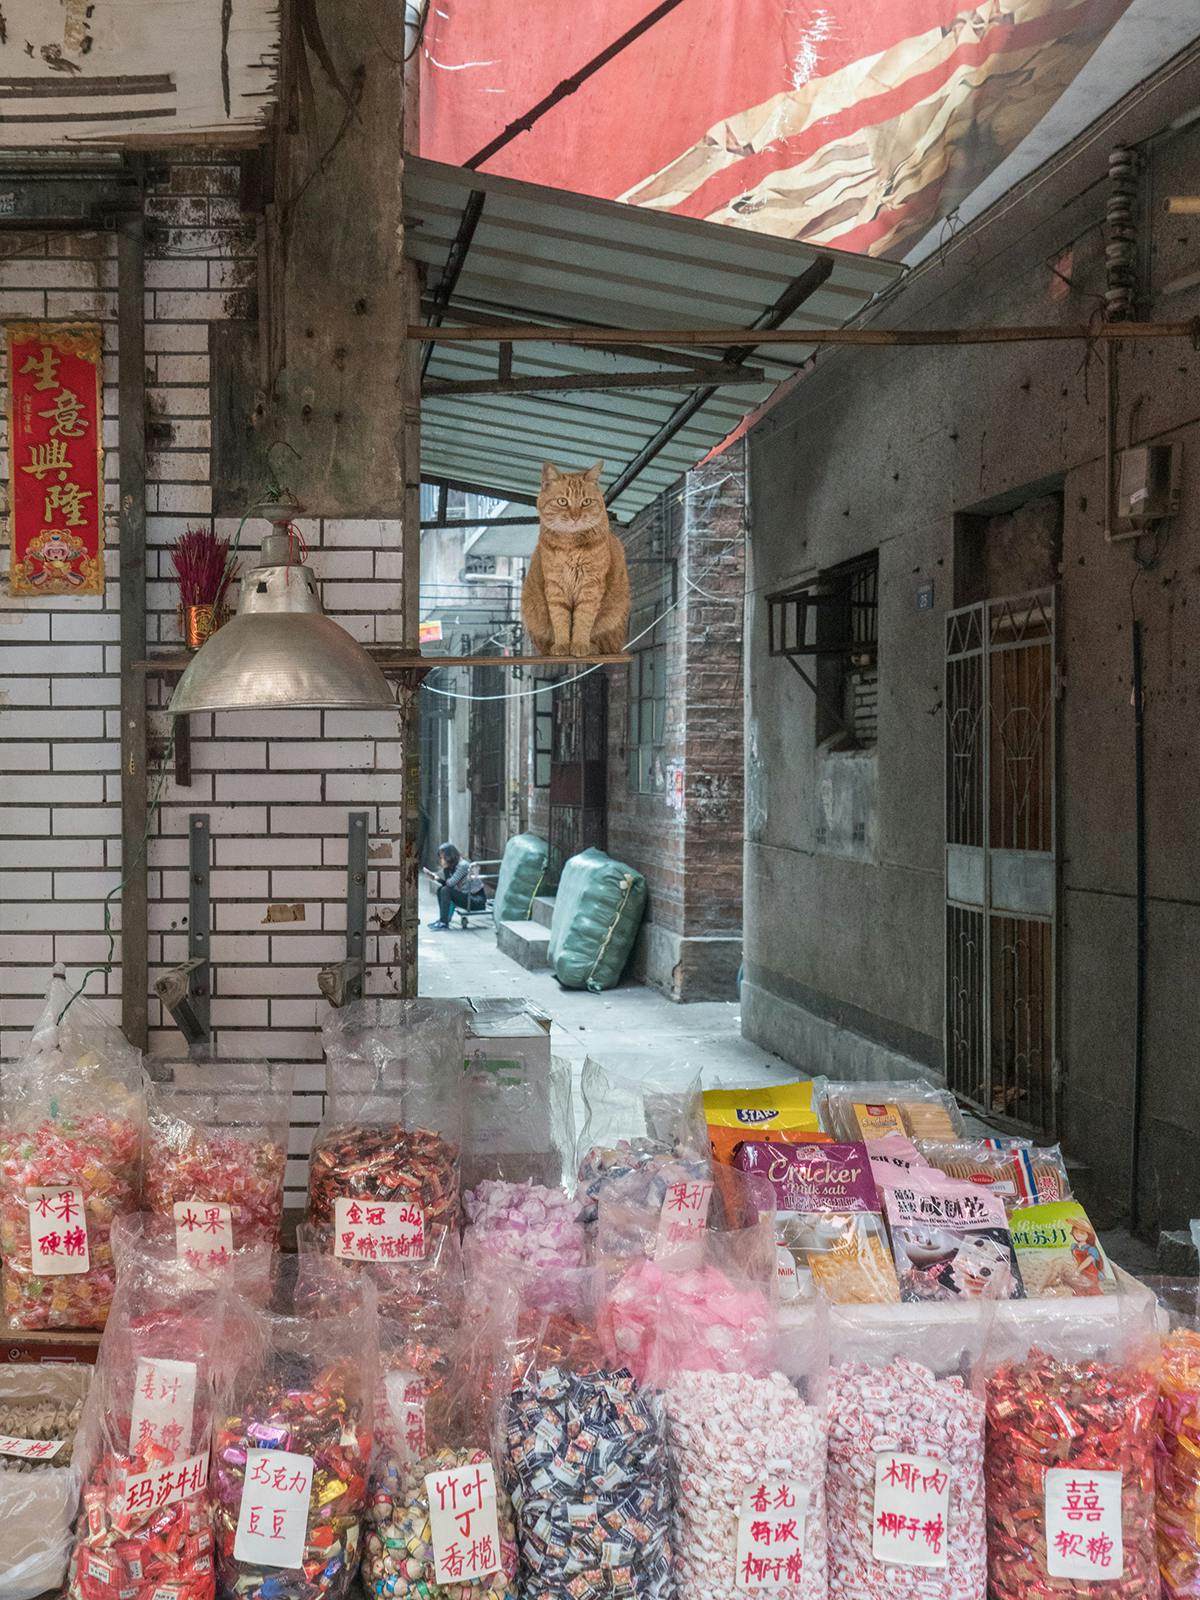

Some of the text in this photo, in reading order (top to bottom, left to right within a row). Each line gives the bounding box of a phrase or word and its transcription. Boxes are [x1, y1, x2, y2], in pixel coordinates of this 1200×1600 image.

[19, 347, 93, 526] 生意興隆
[35, 1190, 80, 1223] 水果
[822, 1184, 848, 1195] salt
[180, 1207, 225, 1235] 水果
[346, 1201, 385, 1225] 金冠
[38, 1225, 87, 1257] 硬糖
[777, 1267, 795, 1276] Milk
[140, 1367, 182, 1404] 姜汁
[126, 1459, 207, 1511] 玛莎牛扎
[250, 1458, 307, 1494] 巧克力
[436, 1469, 488, 1511] 竹叶
[881, 1458, 948, 1495] 椰肉
[750, 1484, 796, 1512] 春光
[247, 1506, 287, 1540] 豆豆
[751, 1519, 799, 1545] 特浓
[877, 1511, 945, 1554] 椰子糖
[741, 1548, 803, 1584] 椰子糖
[1054, 1530, 1114, 1567] 软糖
